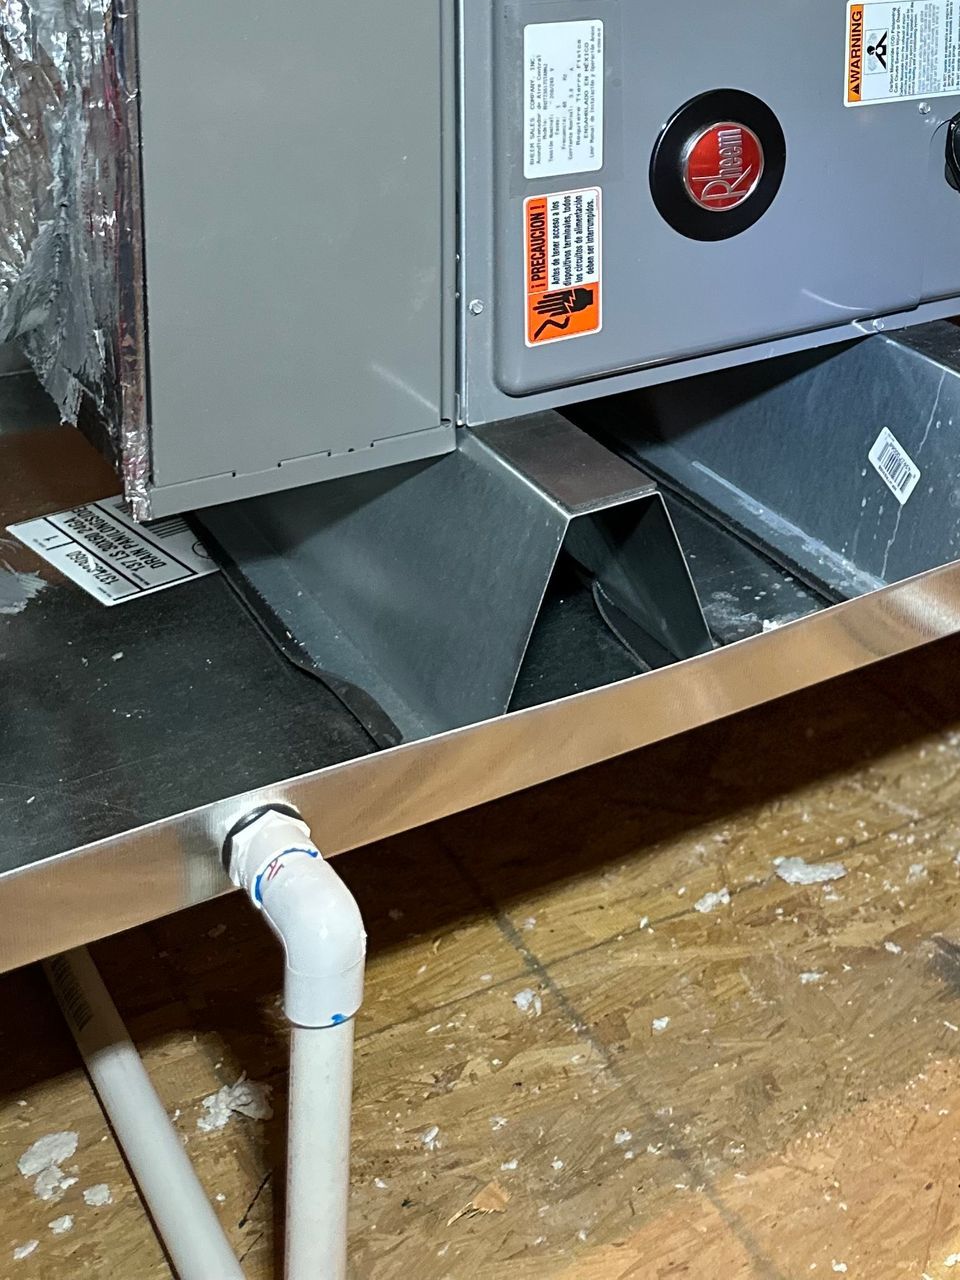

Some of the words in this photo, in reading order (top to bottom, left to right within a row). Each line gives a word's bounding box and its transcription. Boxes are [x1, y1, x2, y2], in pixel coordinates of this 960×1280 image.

[850, 10, 862, 83] WARNING
[584, 76, 589, 85] EN
[692, 128, 753, 200] Rheem
[551, 201, 560, 211] los
[564, 195, 573, 212] todos
[574, 195, 583, 234] alimentación
[586, 198, 596, 243] interrumpidos.
[551, 217, 560, 239] acceso
[564, 213, 573, 248] terminales,
[530, 212, 545, 281] PRECAUCION
[551, 241, 560, 257] tener
[586, 244, 595, 254] ser
[564, 249, 573, 285] dispositivos
[574, 245, 583, 271] circuitos
[586, 256, 595, 274] deben
[551, 266, 560, 284] Antes
[574, 273, 583, 282] los
[61, 516, 94, 534] 24GA
[42, 534, 60, 542] 1
[82, 531, 119, 552] 30X60
[107, 549, 131, 561] LS
[128, 546, 168, 569] DRAIN
[119, 558, 147, 572] 137
